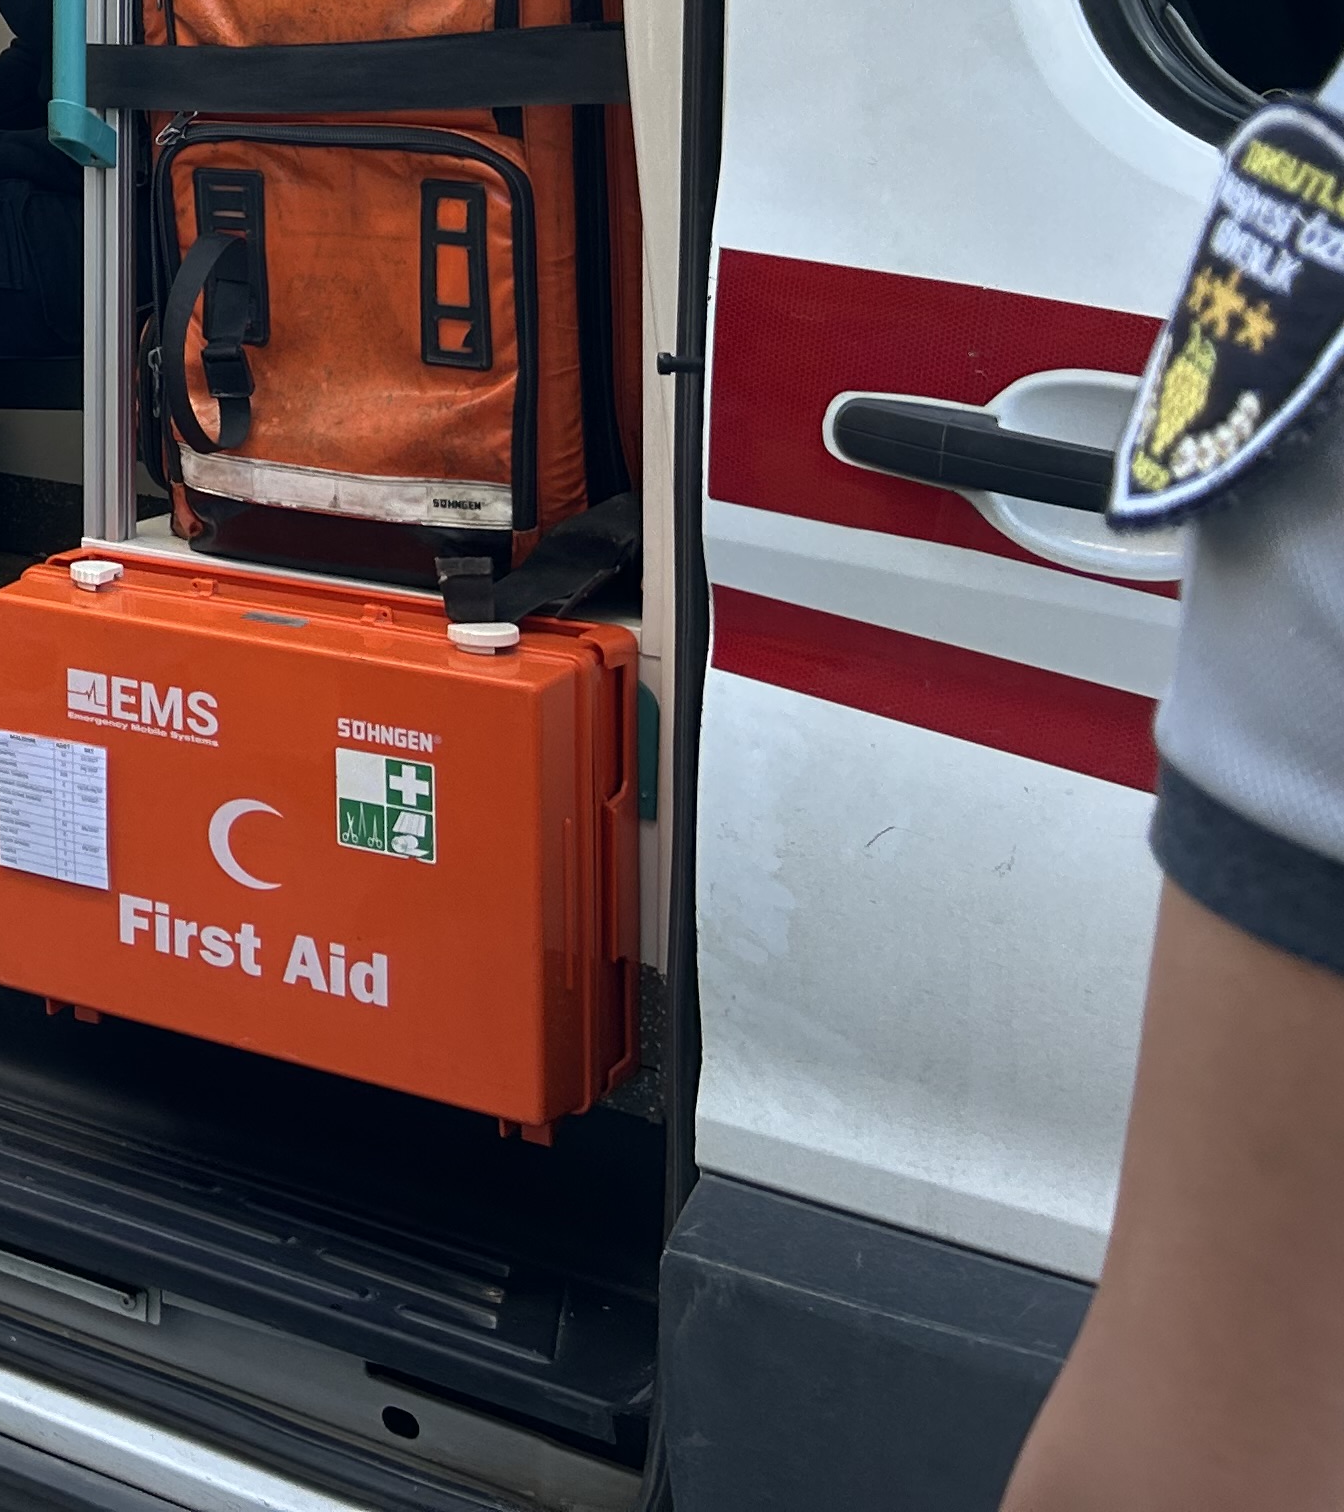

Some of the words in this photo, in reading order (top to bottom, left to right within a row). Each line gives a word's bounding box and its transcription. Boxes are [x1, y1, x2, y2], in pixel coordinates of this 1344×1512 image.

[67, 710, 128, 731] Emergency
[130, 722, 169, 738] Mobile
[170, 730, 220, 748] Systems
[111, 676, 219, 736] EMS
[337, 717, 434, 754] SÖHNGEN
[119, 892, 263, 977] First
[282, 934, 389, 1008] Aid
